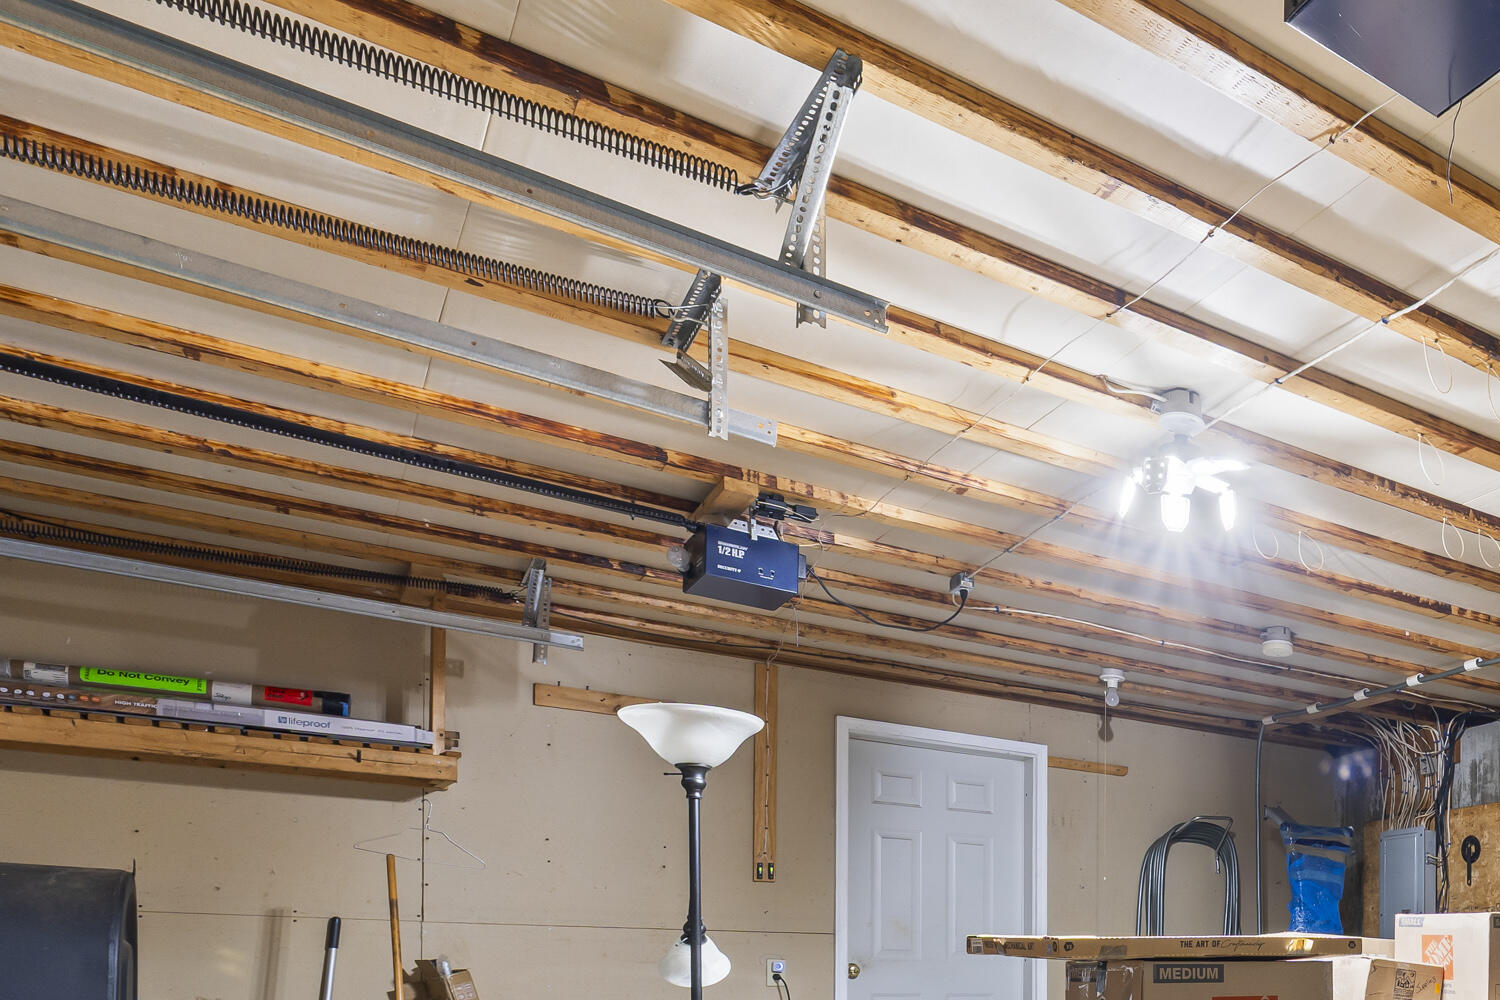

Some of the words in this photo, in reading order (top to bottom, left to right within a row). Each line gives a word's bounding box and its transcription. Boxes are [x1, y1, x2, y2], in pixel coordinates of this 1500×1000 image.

[718, 546, 731, 556] 1/2
[119, 671, 141, 679] Not
[144, 673, 190, 686] Convey
[288, 717, 331, 728] lifeproof
[1180, 940, 1194, 948] THE
[1196, 940, 1210, 948] ART
[1212, 940, 1221, 948] OF
[1159, 967, 1219, 980] MEDIUM
